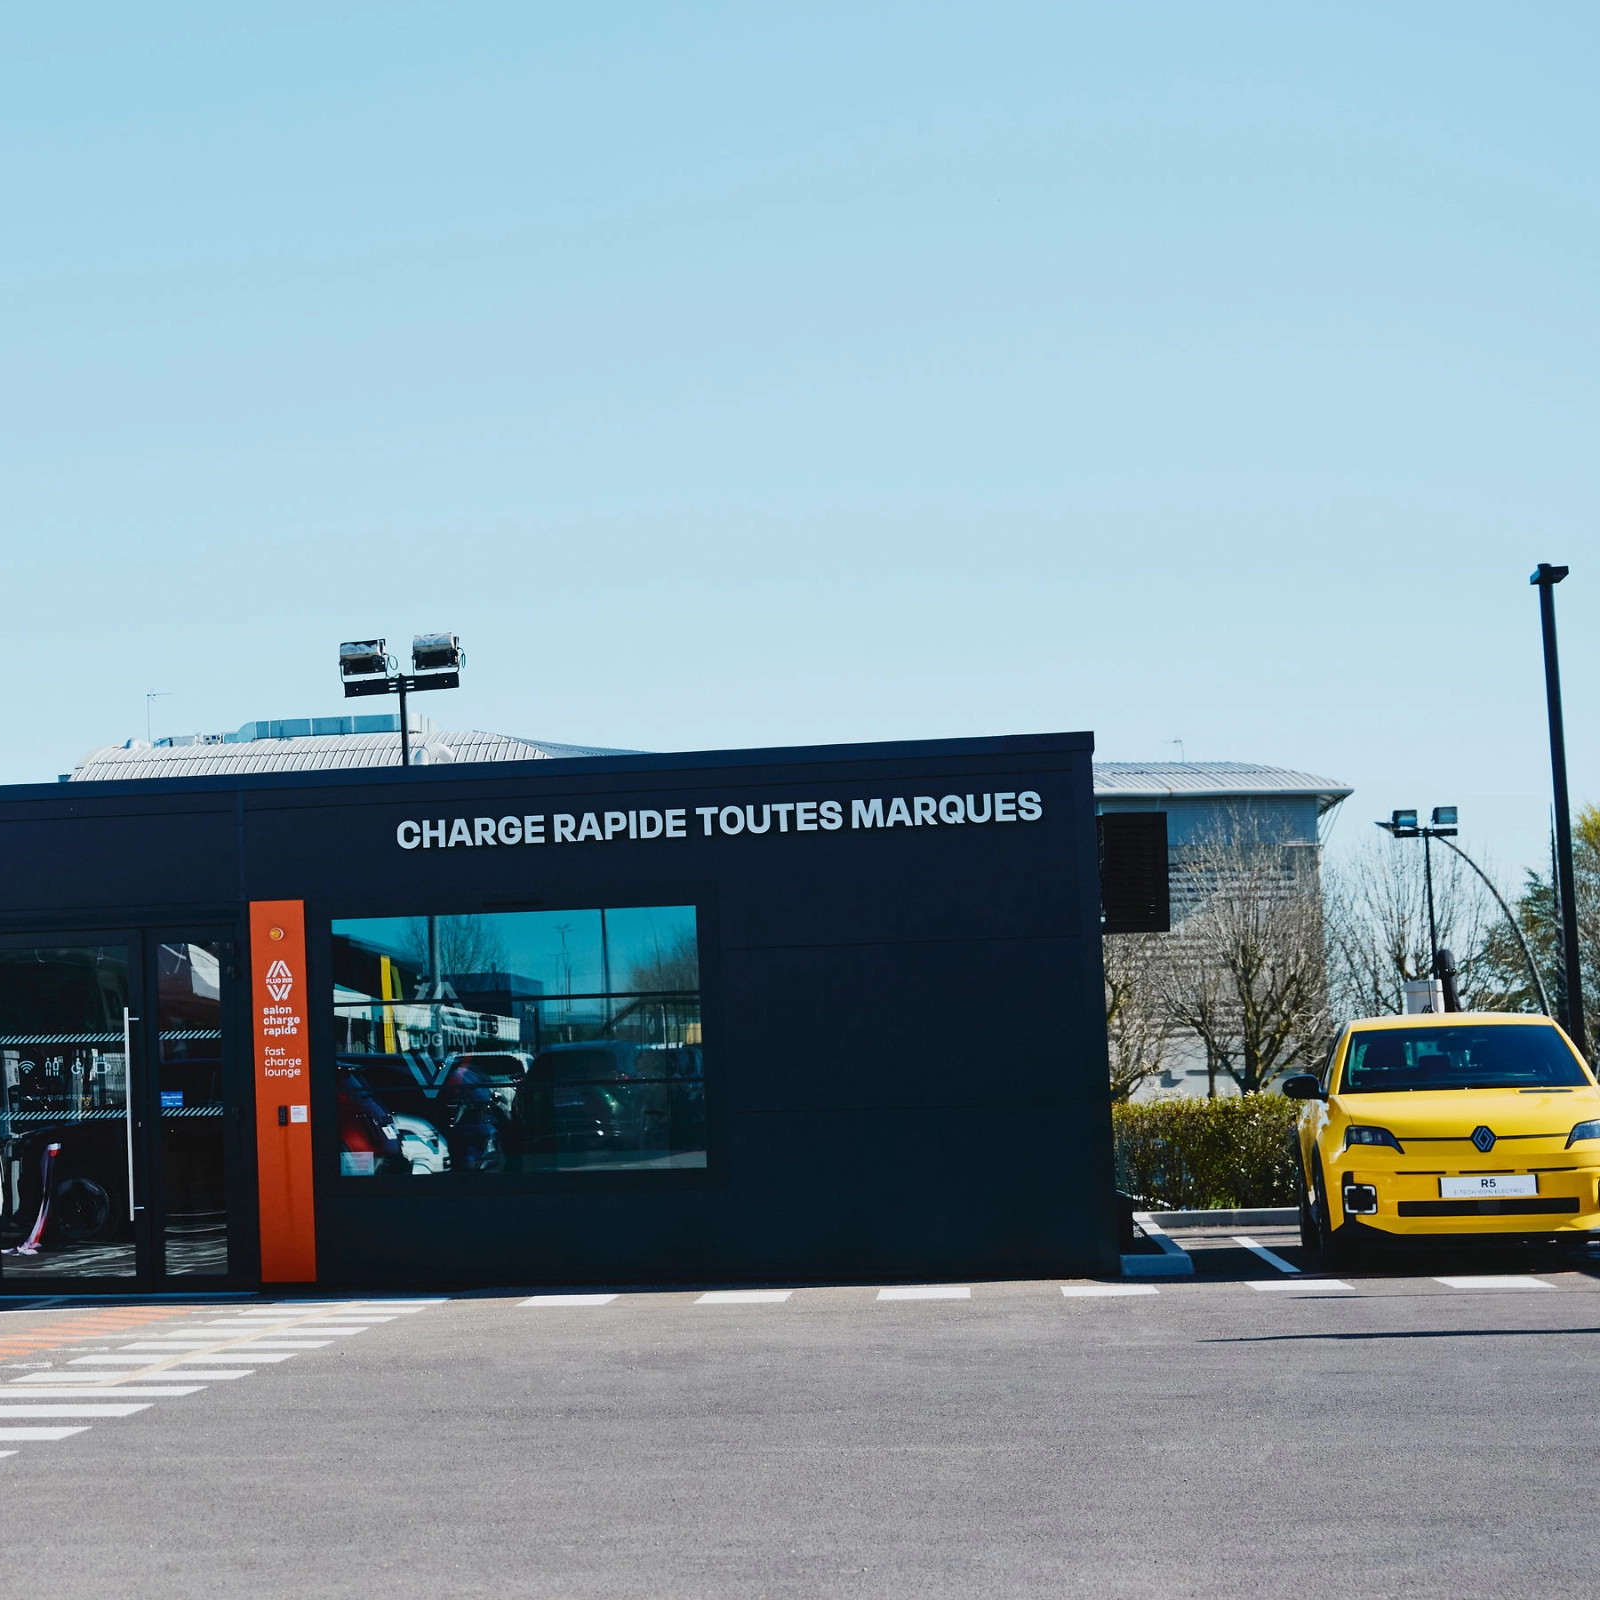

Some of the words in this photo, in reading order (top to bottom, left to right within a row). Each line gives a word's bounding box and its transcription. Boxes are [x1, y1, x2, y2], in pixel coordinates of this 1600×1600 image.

[396, 814, 546, 850] CHARGE
[553, 808, 688, 843] RAPIDE
[695, 800, 843, 836] TOUTES
[851, 791, 1043, 829] MARQUES
[263, 1005, 292, 1015] salon
[263, 1016, 300, 1027] charge
[263, 1025, 297, 1037] rapide
[264, 1046, 285, 1056] fast
[264, 1057, 302, 1068] charge
[264, 1067, 301, 1078] lounge
[1480, 1179, 1497, 1188] R5
